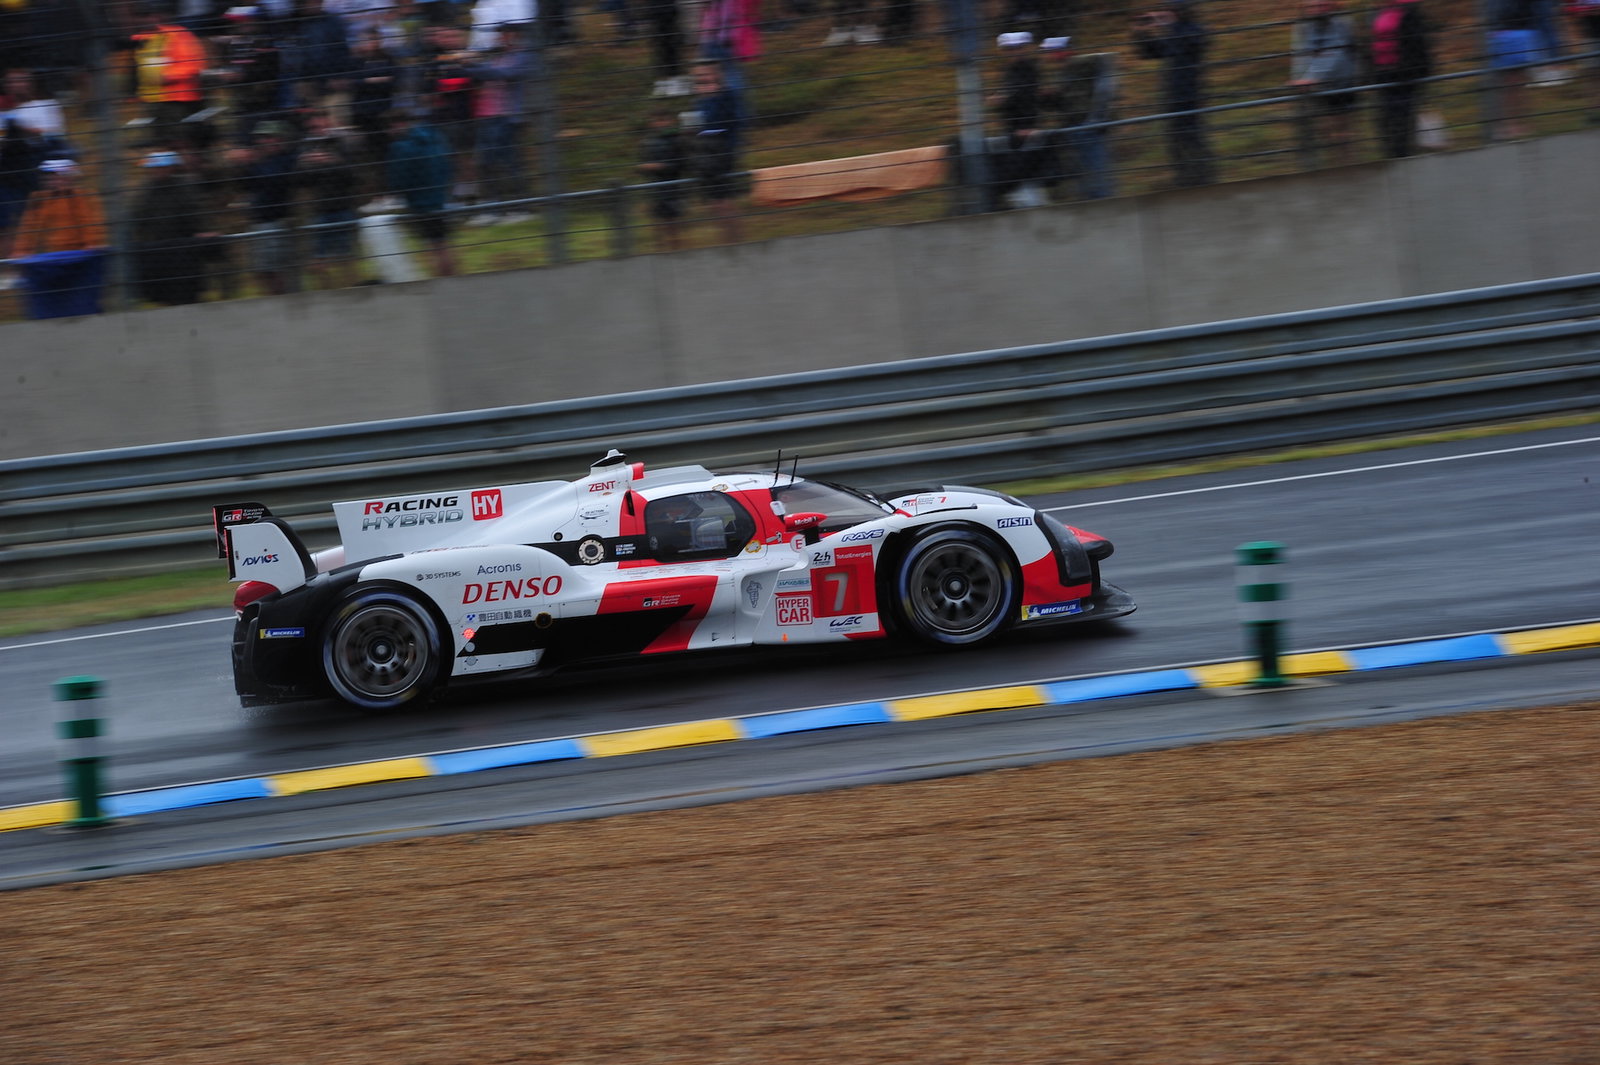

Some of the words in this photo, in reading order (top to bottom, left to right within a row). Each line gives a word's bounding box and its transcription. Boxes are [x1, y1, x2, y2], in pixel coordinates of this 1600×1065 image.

[588, 481, 616, 492] ZENT
[364, 496, 458, 515] RACING
[473, 492, 501, 516] HY
[362, 508, 463, 531] HYBRID
[998, 517, 1032, 528] AISIN
[841, 529, 884, 542] RAYS
[242, 554, 279, 567] ADVICS
[434, 571, 461, 579] SYSTEMS
[476, 563, 522, 576] Acronis
[462, 575, 562, 604] DENSO
[825, 572, 849, 611] 7
[778, 598, 809, 609] HYPER
[1040, 604, 1077, 614] MICHELIN
[779, 608, 810, 624] CAR
[830, 616, 863, 627] WEC
